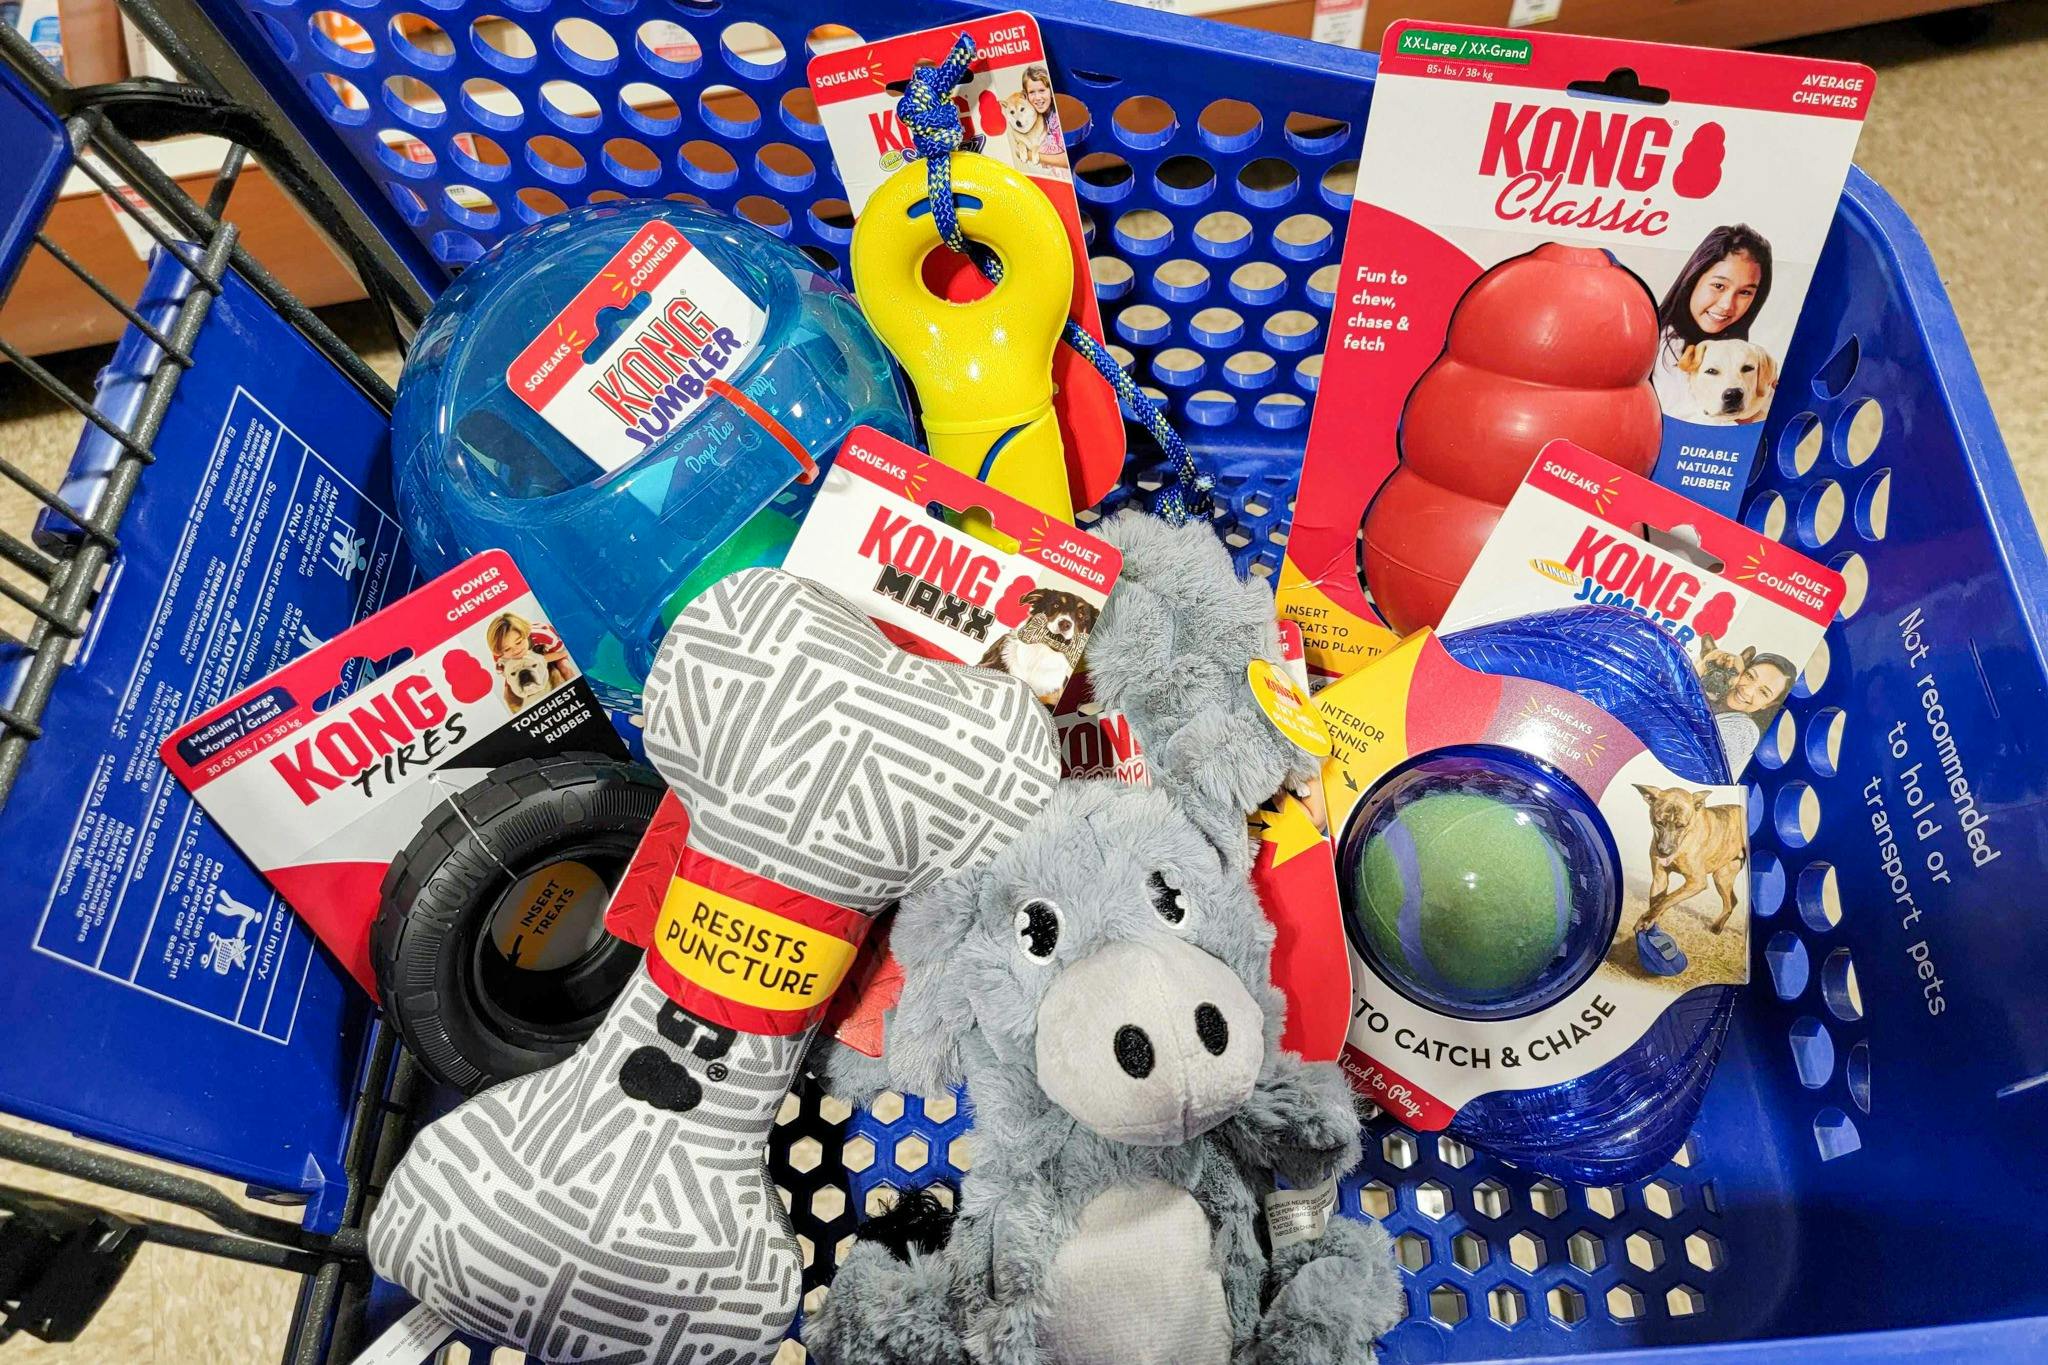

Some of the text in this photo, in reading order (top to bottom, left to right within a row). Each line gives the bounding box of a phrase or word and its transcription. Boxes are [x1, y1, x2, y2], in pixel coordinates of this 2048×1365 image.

[988, 25, 1027, 44] JOUET
[1403, 35, 1456, 55] XX-Large
[1469, 42, 1528, 59] XX-Grand
[815, 67, 869, 88] SQUEAKS
[1443, 64, 1456, 77] lbs
[1481, 69, 1493, 81] kg
[1802, 72, 1863, 92] AVERAGE
[1792, 91, 1858, 109] CHEWERS
[1478, 101, 1673, 193] KONG
[1494, 170, 1670, 237] Classic
[627, 233, 659, 270] JOUET
[630, 236, 679, 288] COUINEUR
[1356, 266, 1408, 286] Fun to
[1352, 290, 1396, 311] chew,
[1348, 312, 1410, 332] chase &
[1343, 333, 1385, 352] fetch
[524, 343, 572, 393] SQUEAKS
[588, 297, 718, 428] KONG
[625, 326, 741, 449] JUMBLER
[226, 425, 236, 438] El
[706, 420, 736, 458] Nee
[214, 436, 231, 469] asiento
[849, 444, 908, 481] SQUEAKS
[1677, 460, 1734, 478] NATURAL
[1680, 446, 1739, 463] DURABLE
[209, 469, 219, 486] del
[265, 481, 277, 496] Su
[1543, 460, 1601, 495] SQUEAKS
[1681, 475, 1731, 492] RUBBER
[199, 485, 213, 510] carro
[321, 486, 339, 532] ALWAYS
[194, 510, 204, 523] es
[252, 519, 262, 534] se
[287, 502, 303, 538] ONLY
[177, 523, 199, 573] solamente
[241, 533, 257, 568] puede
[279, 538, 291, 560] use
[858, 505, 1000, 606] KONG
[1059, 539, 1101, 563] JOUET
[168, 572, 181, 597] para
[233, 569, 245, 593] caer
[270, 561, 283, 585] cart
[452, 566, 500, 600] POWER
[1041, 549, 1106, 586] COUINEUR
[1565, 525, 1701, 621] KONG
[1787, 571, 1832, 598] JOUET
[227, 594, 237, 609] de
[262, 585, 275, 612] seat
[447, 581, 509, 623] CHEWERS
[873, 564, 995, 643] MAXX
[1757, 571, 1825, 612] COUINEUR
[158, 597, 173, 625] niños
[223, 610, 232, 622] el
[257, 612, 269, 630] for
[1285, 604, 1329, 619] INSERT
[1295, 620, 1348, 637] EATS TO
[1574, 578, 1695, 647] JUMER
[150, 641, 159, 650] 6
[153, 626, 164, 640] de
[210, 622, 228, 658] carrito
[280, 607, 302, 661] STAY with
[1303, 637, 1329, 650] END
[1332, 641, 1364, 655] PLAY
[141, 659, 152, 674] 48
[197, 668, 212, 700] sufrir
[127, 674, 146, 711] meses
[512, 685, 579, 732] TOUGHEST
[189, 718, 234, 746] Medium
[246, 694, 275, 717] Large
[200, 733, 238, 757] Moyen
[247, 704, 282, 729] Grand
[529, 700, 586, 737] NATURAL
[545, 710, 592, 745] RUBBER
[1320, 701, 1385, 743] INTERIOR
[1544, 704, 1593, 735] SQUEAKS
[207, 757, 236, 776] 30-65
[237, 746, 253, 761] lbs
[260, 728, 288, 745] 13-30
[286, 718, 303, 735] kg
[270, 673, 448, 807] KONG
[351, 712, 468, 798] TIRES
[1058, 714, 1143, 778] KON
[1898, 607, 2001, 869] Not recommended
[258, 552, 388, 980] Your child injury.
[90, 765, 113, 807] HASTA
[1888, 719, 1951, 885] to hold or
[85, 810, 97, 824] 16
[151, 816, 163, 829] la
[156, 798, 167, 815] en
[76, 825, 92, 842] kg.
[178, 829, 198, 869] 15-35
[133, 831, 156, 882] cabeza.
[187, 853, 204, 892] carrier
[77, 821, 125, 942] asiento personal para
[81, 858, 103, 901] asiento
[94, 826, 135, 926] NO USE su propio
[169, 870, 185, 895] lbs.
[75, 902, 87, 918] de
[181, 857, 213, 940] own personal
[181, 895, 190, 909] or
[520, 879, 560, 928] INSERT
[532, 887, 575, 936] TREATS
[1863, 775, 1946, 1017] transport pets
[174, 911, 185, 931] car
[183, 862, 224, 969] Do NOT use your
[692, 901, 808, 964] RESISTS
[666, 919, 819, 996] PUNCTURE
[1354, 995, 1617, 1069] TO CATCH & CHASE
[1372, 1073, 1388, 1090] to
